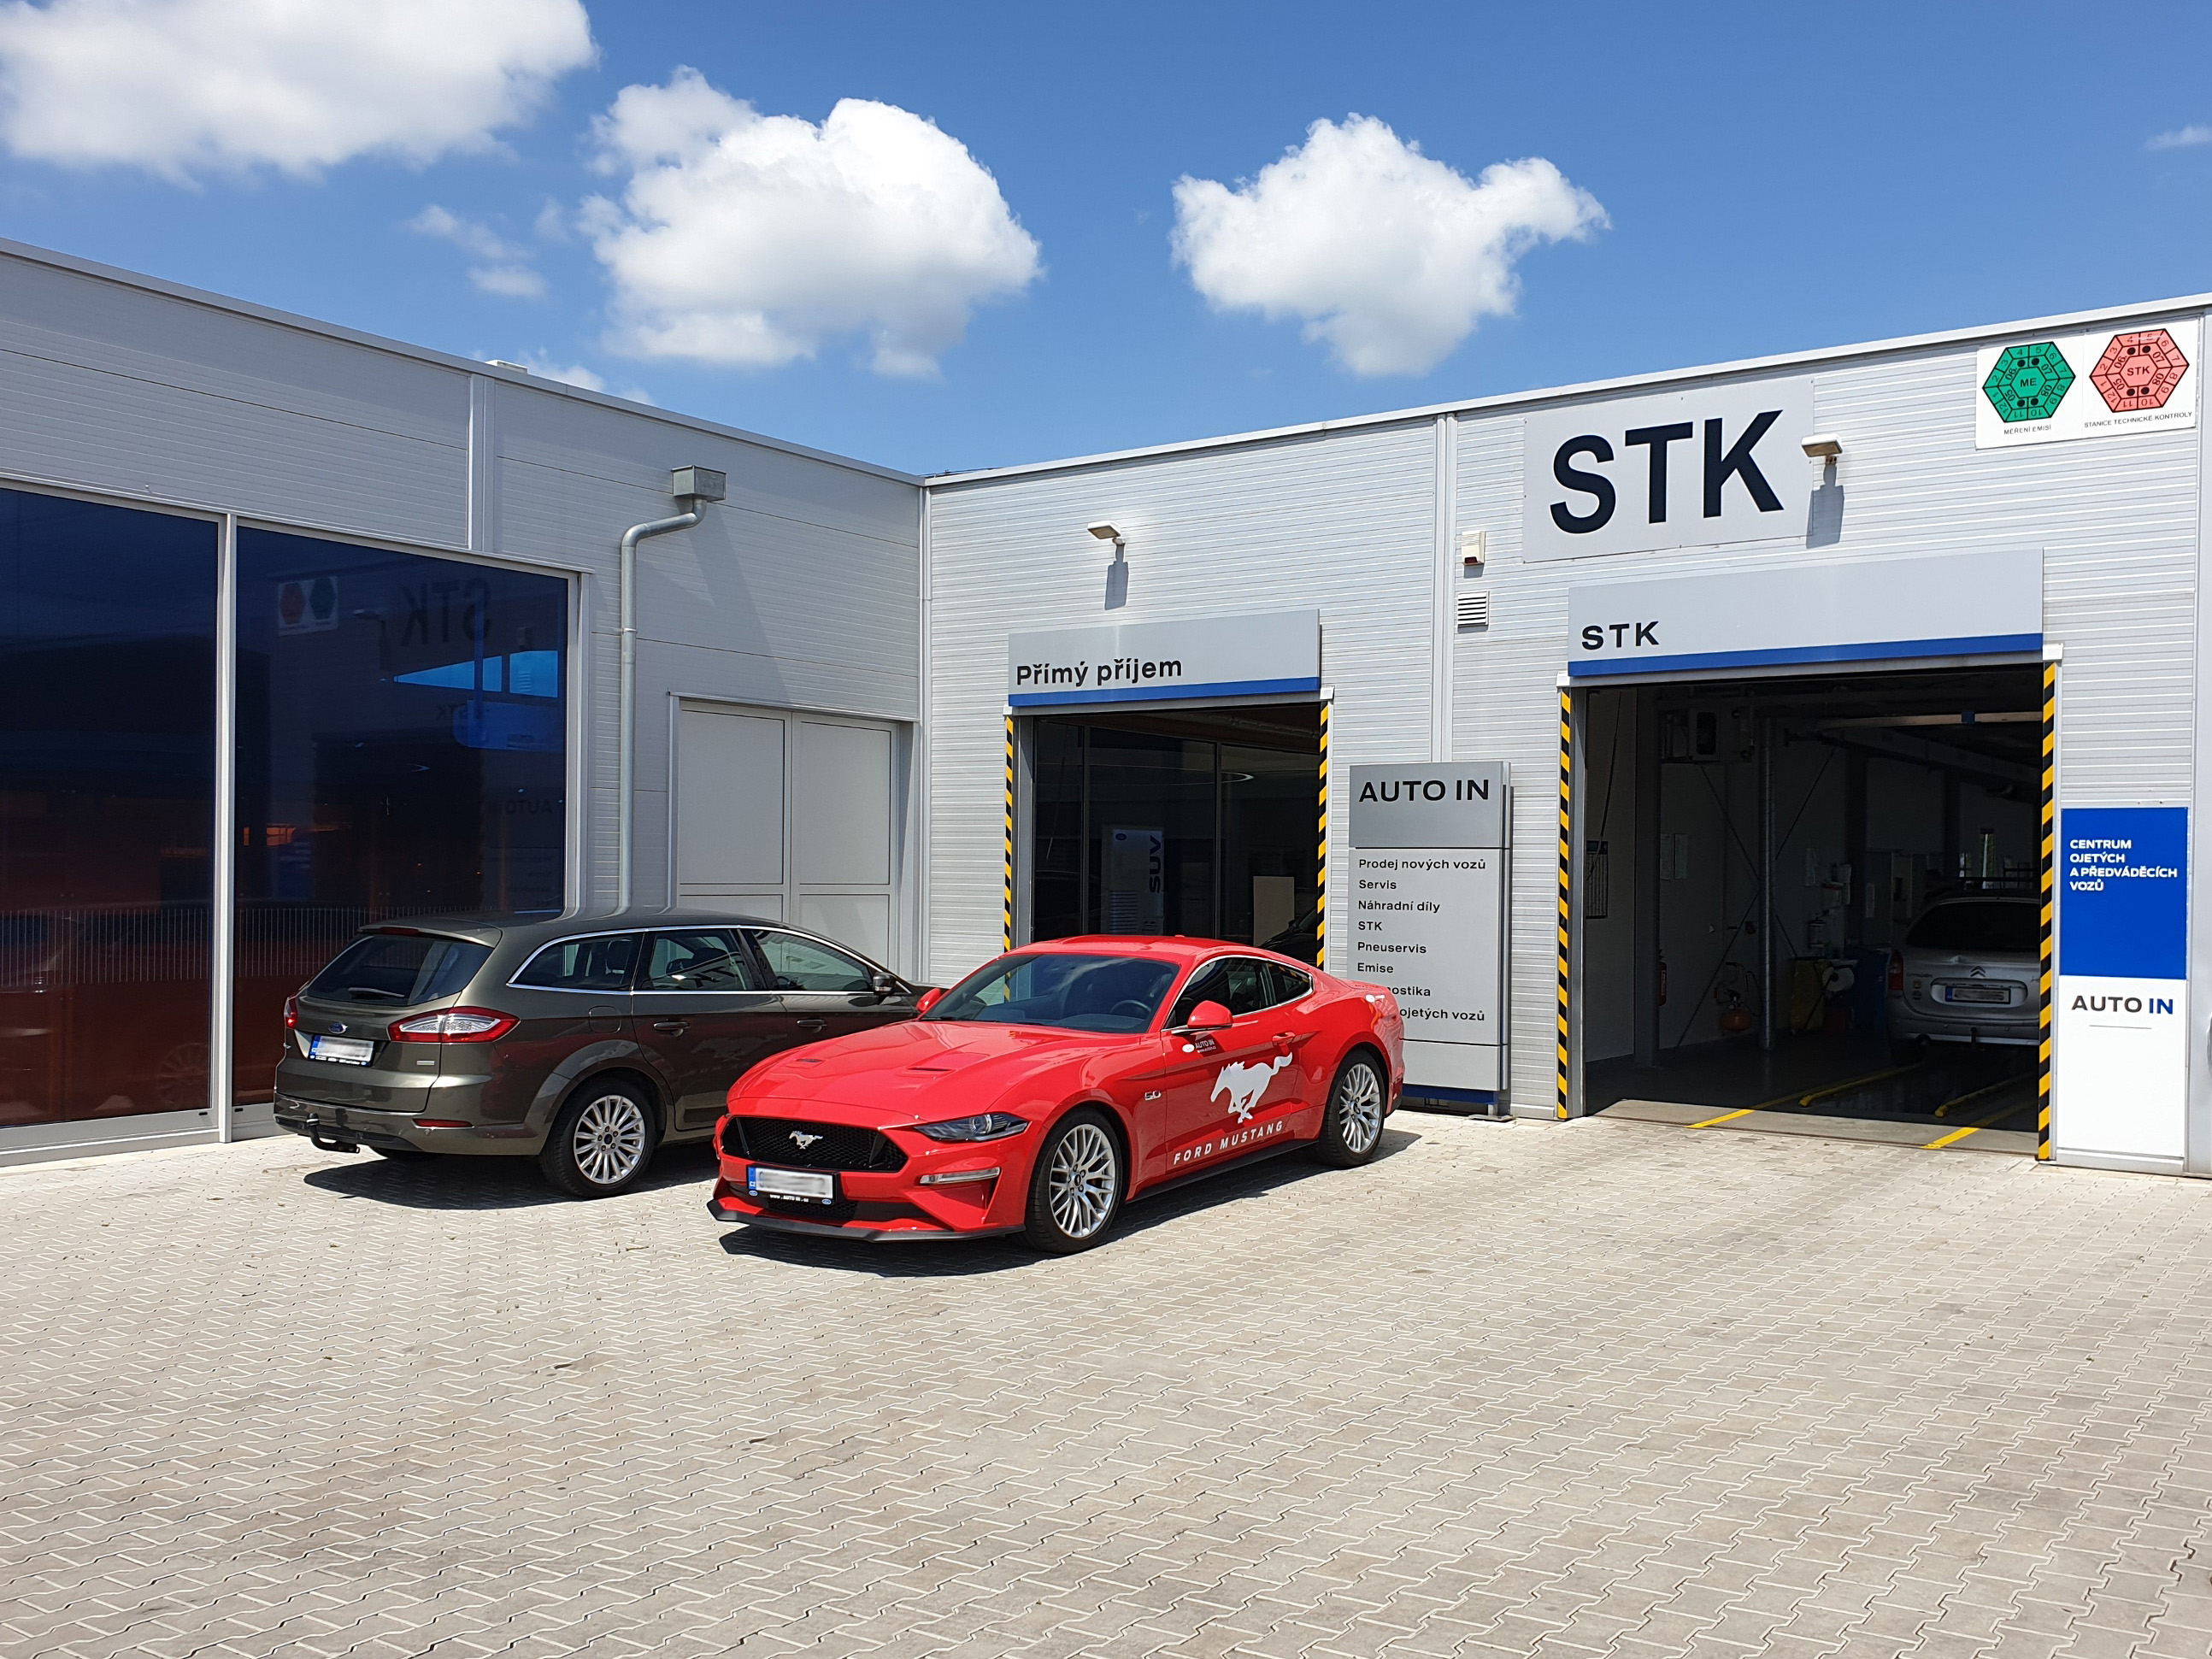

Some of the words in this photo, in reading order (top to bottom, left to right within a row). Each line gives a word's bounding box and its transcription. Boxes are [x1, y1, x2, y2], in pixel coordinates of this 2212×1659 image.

[2152, 351, 2164, 362] 07
[2041, 364, 2053, 374] 07
[2127, 366, 2150, 376] STK
[2021, 378, 2037, 387] ME
[2113, 378, 2125, 391] 05
[2152, 373, 2164, 385] 08
[2005, 390, 2015, 402] 05
[2041, 385, 2052, 397] 08
[2108, 391, 2117, 403] 12
[1999, 403, 2009, 413] 12
[2084, 420, 2111, 428] STANICE
[2114, 415, 2152, 424] TECHNICKÉ
[2155, 412, 2192, 421] KONTROLY
[1550, 409, 1785, 534] STK
[1582, 621, 1659, 650] STK
[1017, 662, 1089, 687] Přímý
[1097, 657, 1181, 685] příjem
[1359, 779, 1446, 802] AUTO
[1456, 779, 1489, 800] IN
[2069, 839, 2132, 850] CENTRUM
[2069, 851, 2126, 863] OJETÝCH
[1149, 835, 1162, 894] SUV
[1359, 859, 1398, 870] Prodej
[1402, 858, 1450, 871] nových
[1453, 859, 1485, 869] vozů
[2069, 868, 2079, 877] A
[2080, 866, 2178, 878] PŘEDVÁDĚCÍCH
[1359, 880, 1397, 889] Servis
[2069, 879, 2104, 891] VOZŮ
[1358, 900, 1414, 911] Náhradní
[1417, 901, 1440, 913] díly
[1358, 921, 1383, 931] STK
[1357, 942, 1427, 954] Pneuservis
[1357, 962, 1394, 974] Emise
[1386, 986, 1431, 997] ostika
[2072, 995, 2142, 1013] AUTO
[2149, 998, 2174, 1015] IN
[1399, 1007, 1448, 1020] ojetých
[1452, 1010, 1485, 1021] vozů
[1174, 1143, 1212, 1165] FORD
[1220, 1121, 1284, 1150] MUSTANG
